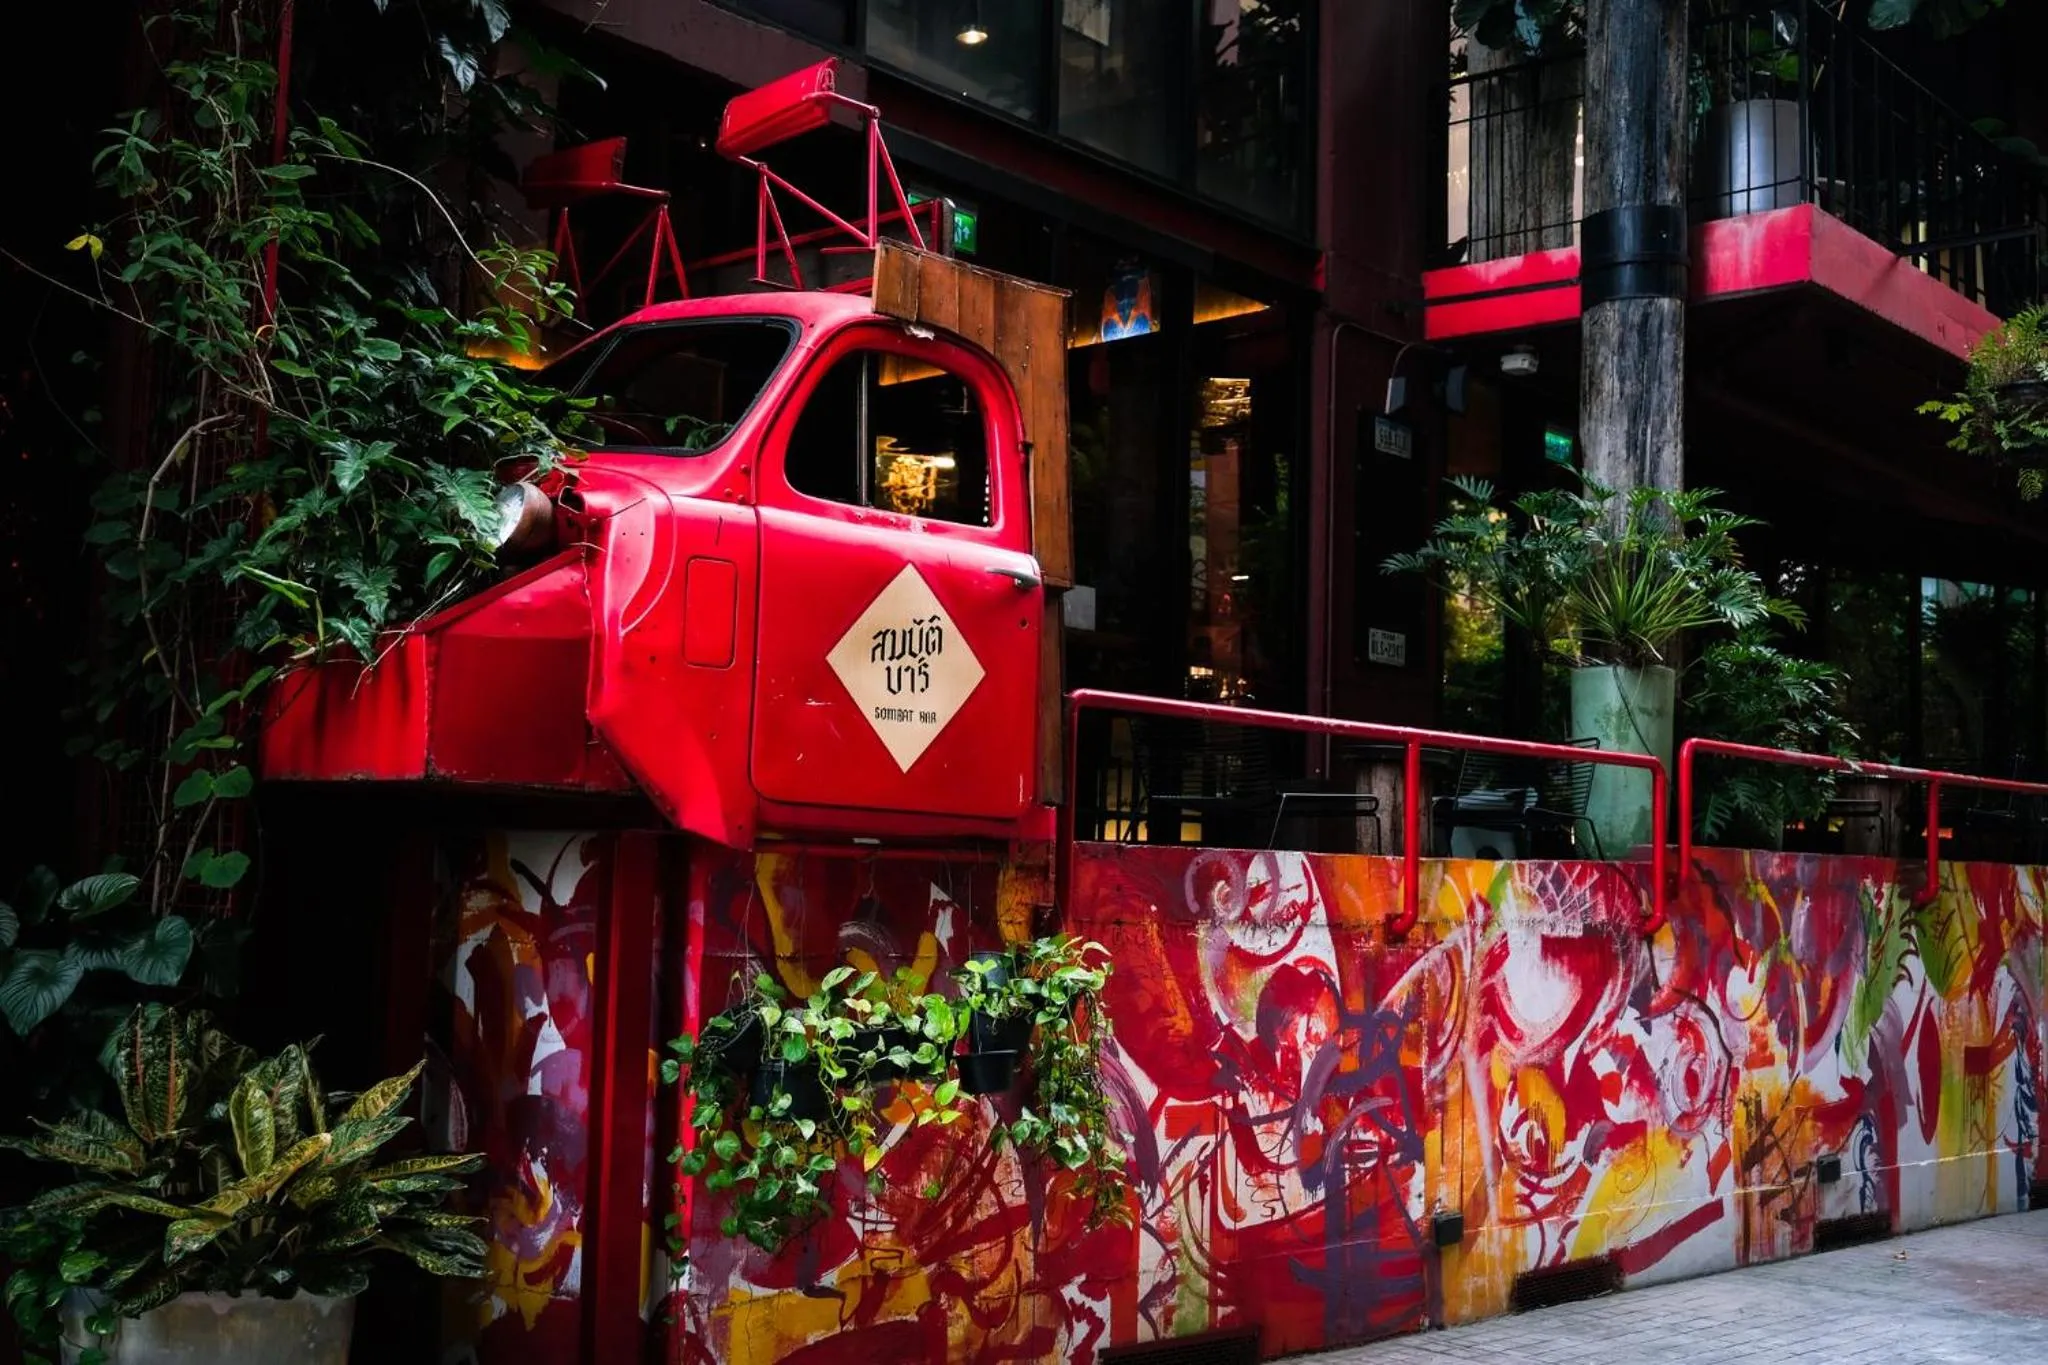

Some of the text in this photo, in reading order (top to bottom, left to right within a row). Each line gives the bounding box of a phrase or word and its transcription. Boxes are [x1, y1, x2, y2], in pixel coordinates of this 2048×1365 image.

[871, 614, 943, 663] สมบัติ
[885, 657, 930, 695] บาร์
[874, 706, 937, 724] SOMBAT BAR
